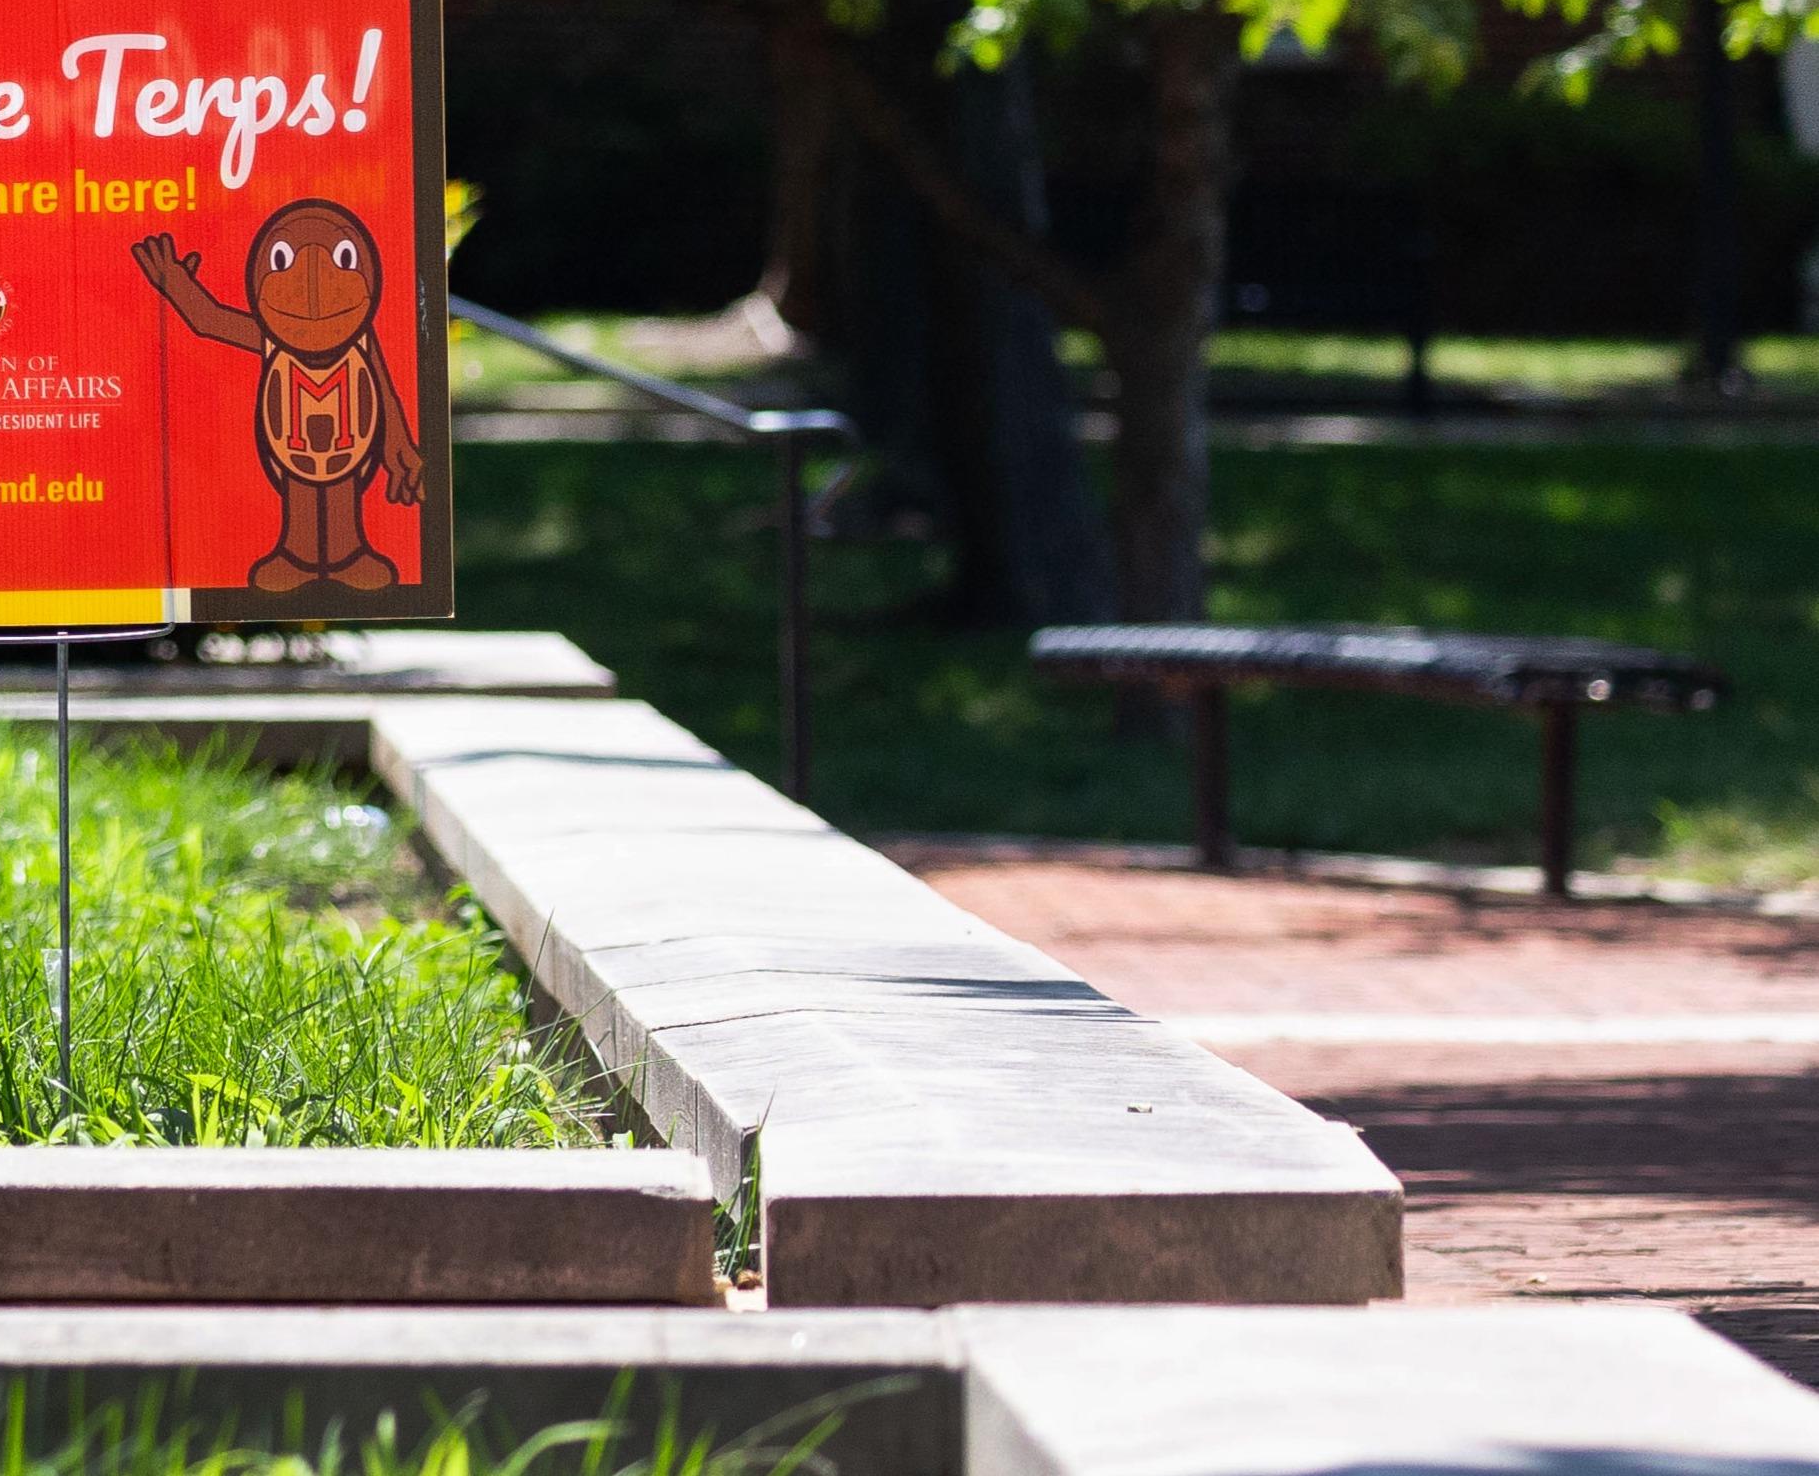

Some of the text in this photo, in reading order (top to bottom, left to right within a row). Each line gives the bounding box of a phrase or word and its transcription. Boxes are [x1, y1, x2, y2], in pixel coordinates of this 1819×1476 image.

[61, 27, 383, 191] Terps!
[74, 166, 198, 214] here!
[27, 355, 60, 372] OF
[2, 375, 123, 401] AFFAIRS
[69, 412, 102, 429] LIFE
